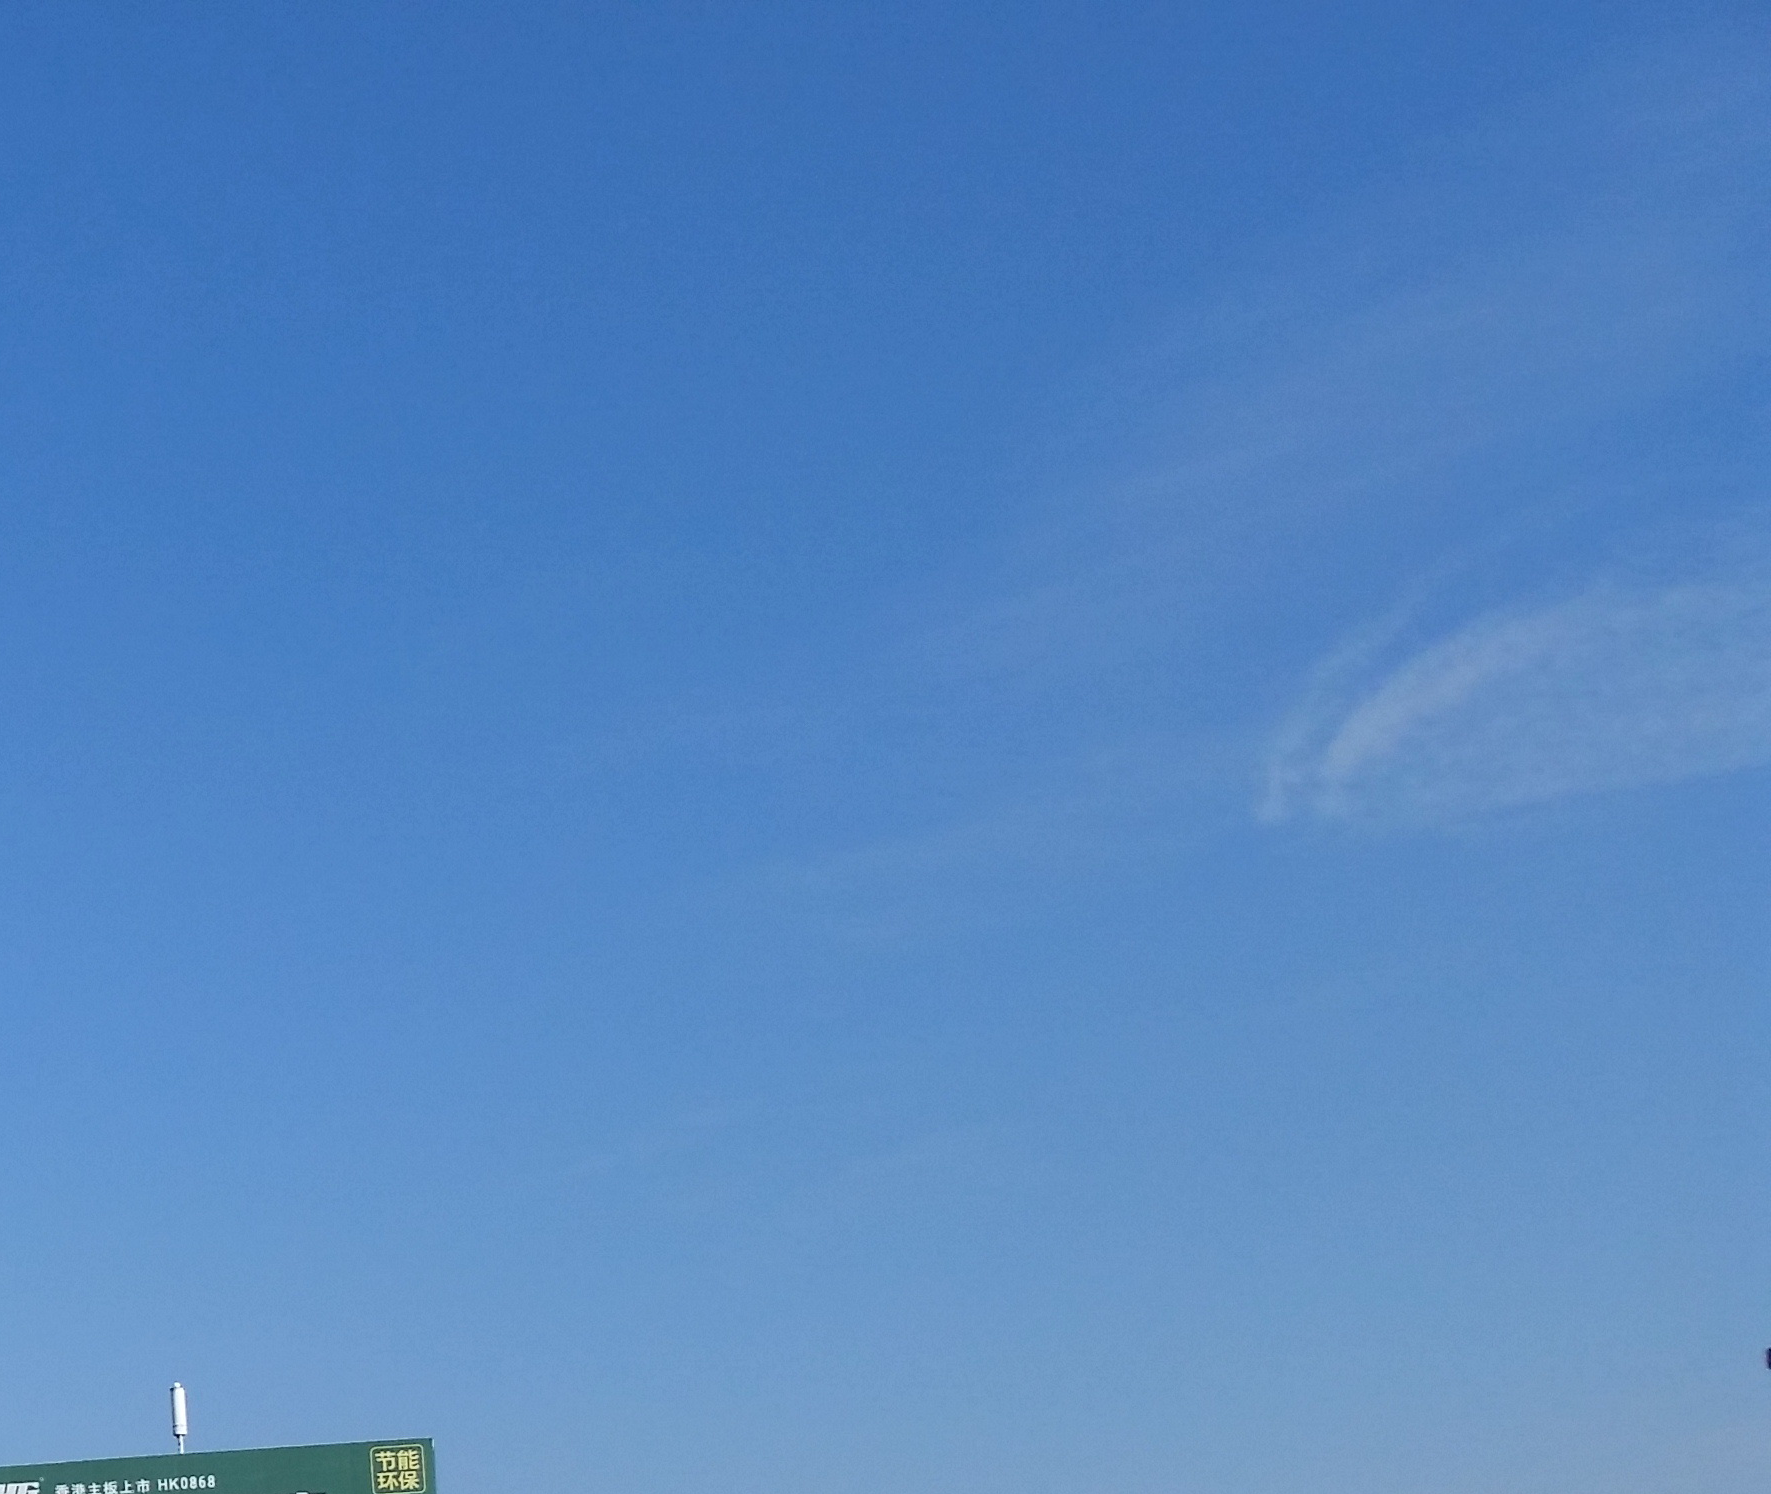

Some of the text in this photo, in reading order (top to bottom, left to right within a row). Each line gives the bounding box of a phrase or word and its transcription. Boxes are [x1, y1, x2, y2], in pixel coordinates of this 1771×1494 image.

[375, 1450, 420, 1472] 节能
[157, 1475, 216, 1491] HK0868
[376, 1471, 420, 1491] 环保
